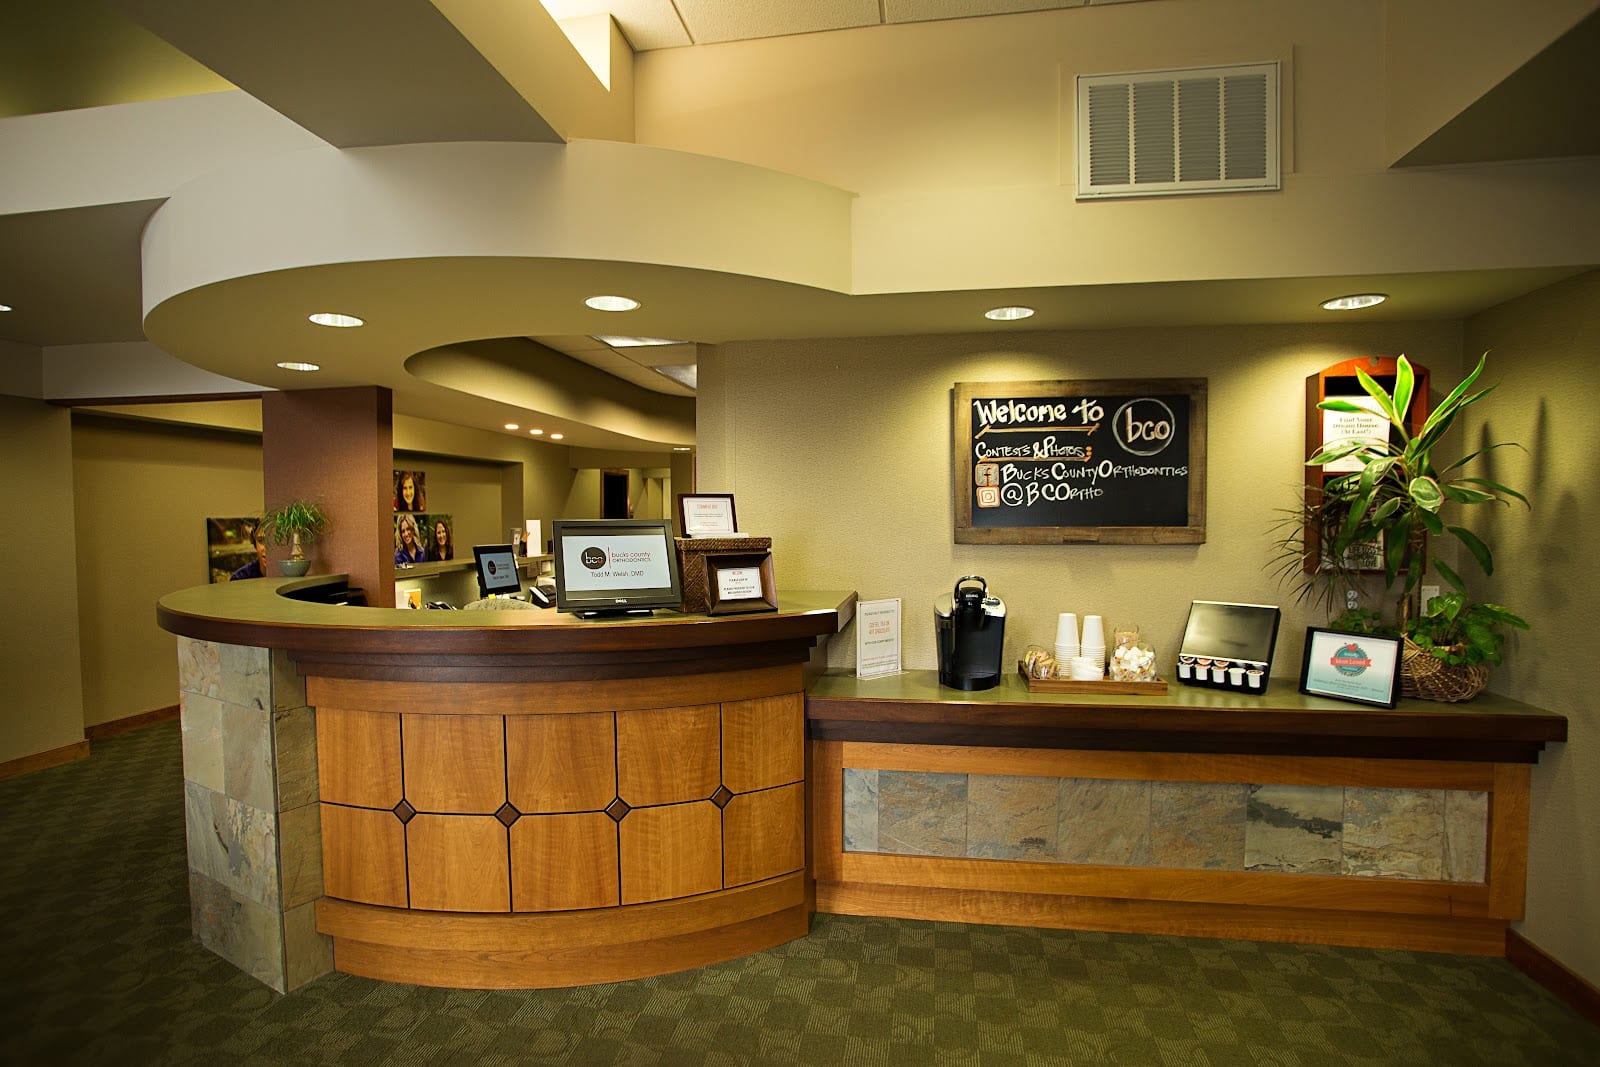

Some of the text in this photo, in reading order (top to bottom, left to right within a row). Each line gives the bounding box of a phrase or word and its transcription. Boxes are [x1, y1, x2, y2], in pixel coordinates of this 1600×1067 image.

[973, 398, 1104, 427] Welcome to
[1126, 405, 1170, 444] bco
[1000, 462, 1049, 484] BUCKS
[1051, 461, 1099, 486] COUNTY
[1097, 459, 1189, 479] ORTHODONTICS
[584, 551, 603, 564] bco
